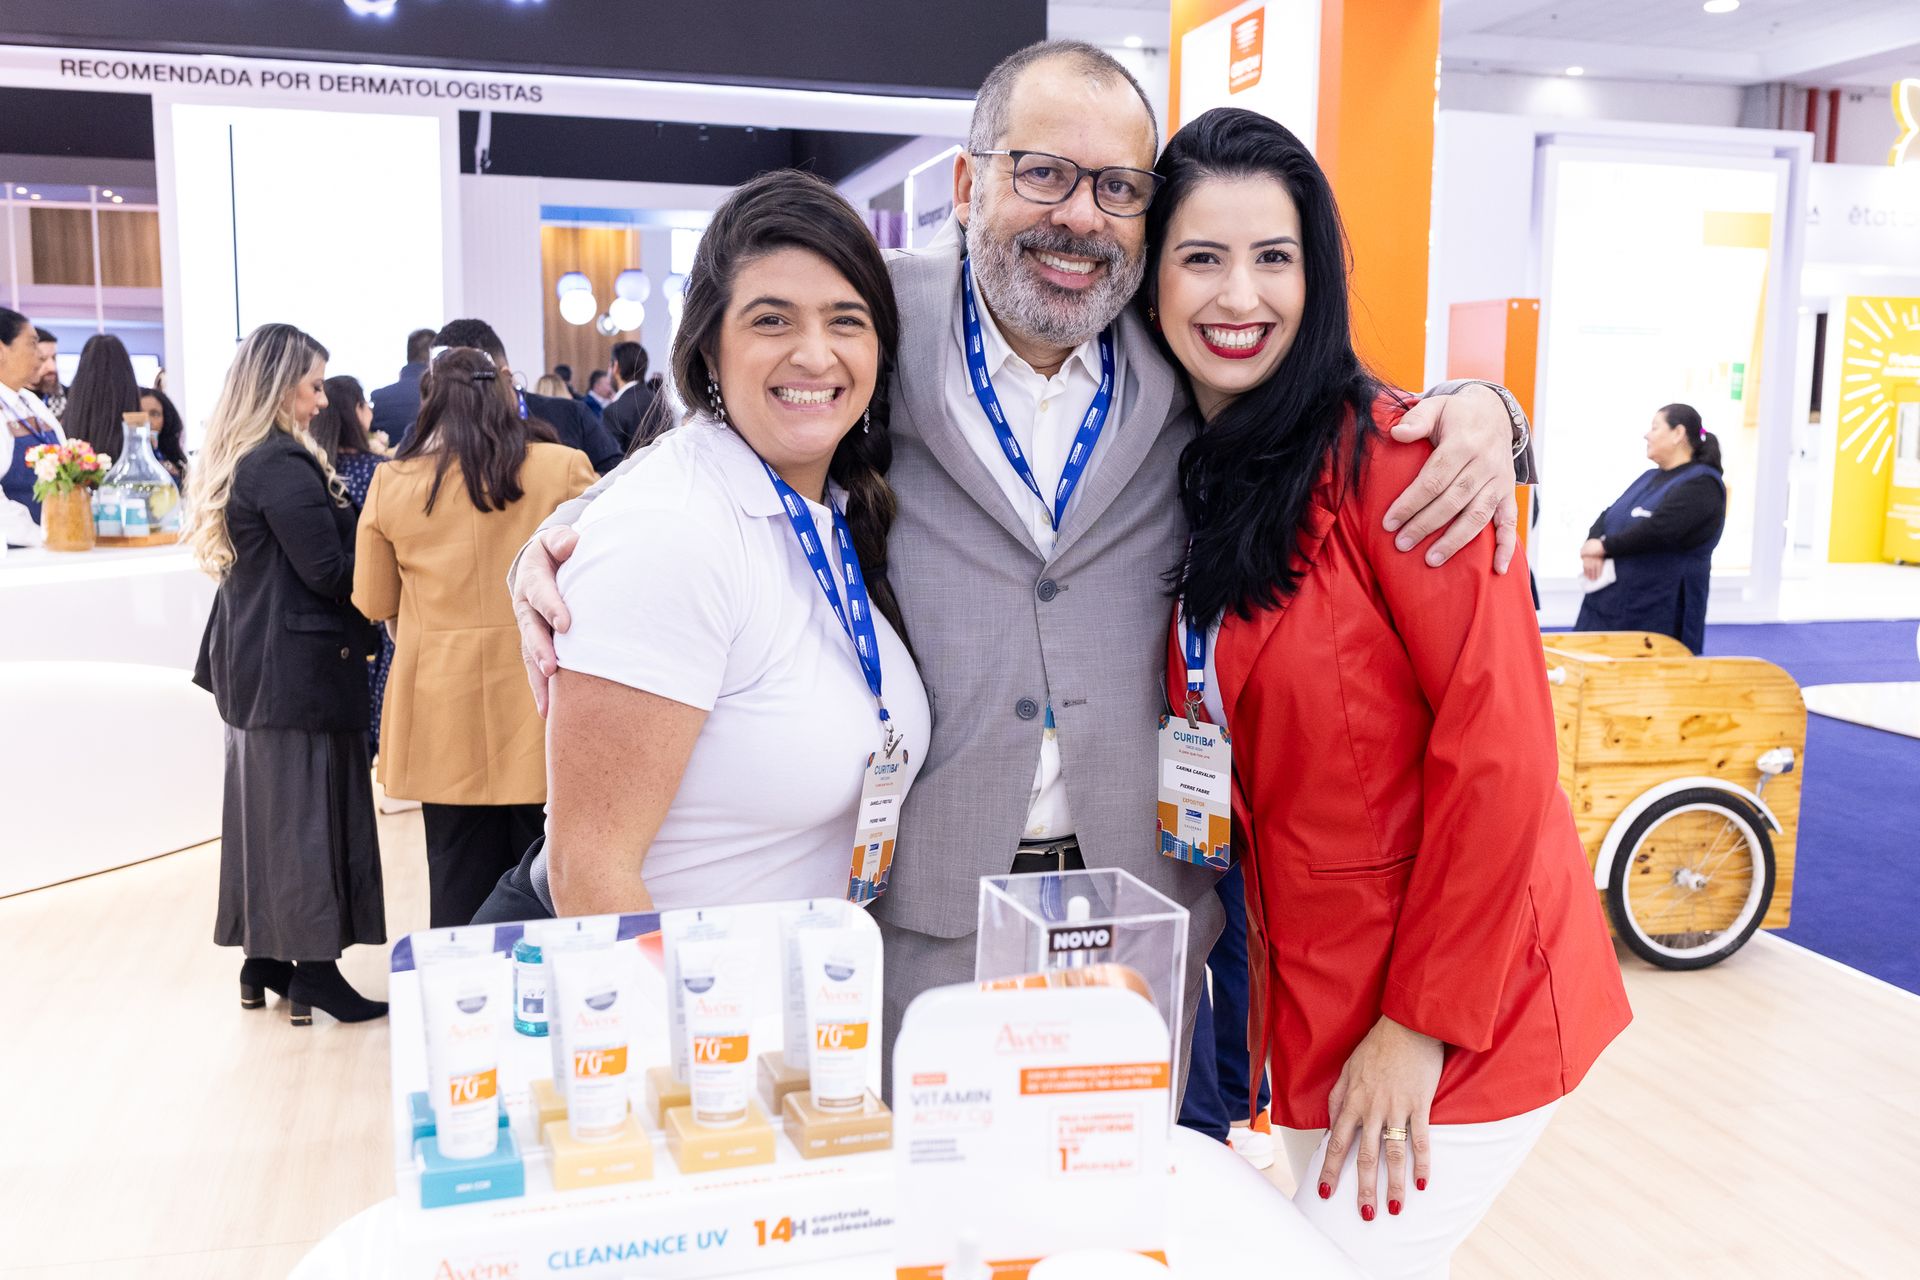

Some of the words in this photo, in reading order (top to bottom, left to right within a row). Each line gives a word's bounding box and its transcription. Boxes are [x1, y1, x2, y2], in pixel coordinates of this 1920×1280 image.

[60, 58, 253, 88] RECOMENDADA
[261, 71, 311, 91] POR
[319, 74, 543, 104] DERMATOLOGISTAS
[1176, 765, 1192, 773] CARINA
[1193, 769, 1215, 779] CARVALHO
[1180, 783, 1195, 791] PIERRE
[1196, 787, 1210, 795] FABRE
[1053, 928, 1110, 949] NOVO
[817, 1024, 843, 1047] 70
[695, 1037, 721, 1060] 70
[575, 1050, 603, 1075] 70
[450, 1076, 479, 1103] 70
[911, 1089, 992, 1106] VITAMIN
[812, 1207, 870, 1224] controle
[832, 1216, 895, 1234] oleosida
[548, 1233, 688, 1271] CLEANANCE
[697, 1228, 728, 1250] UV
